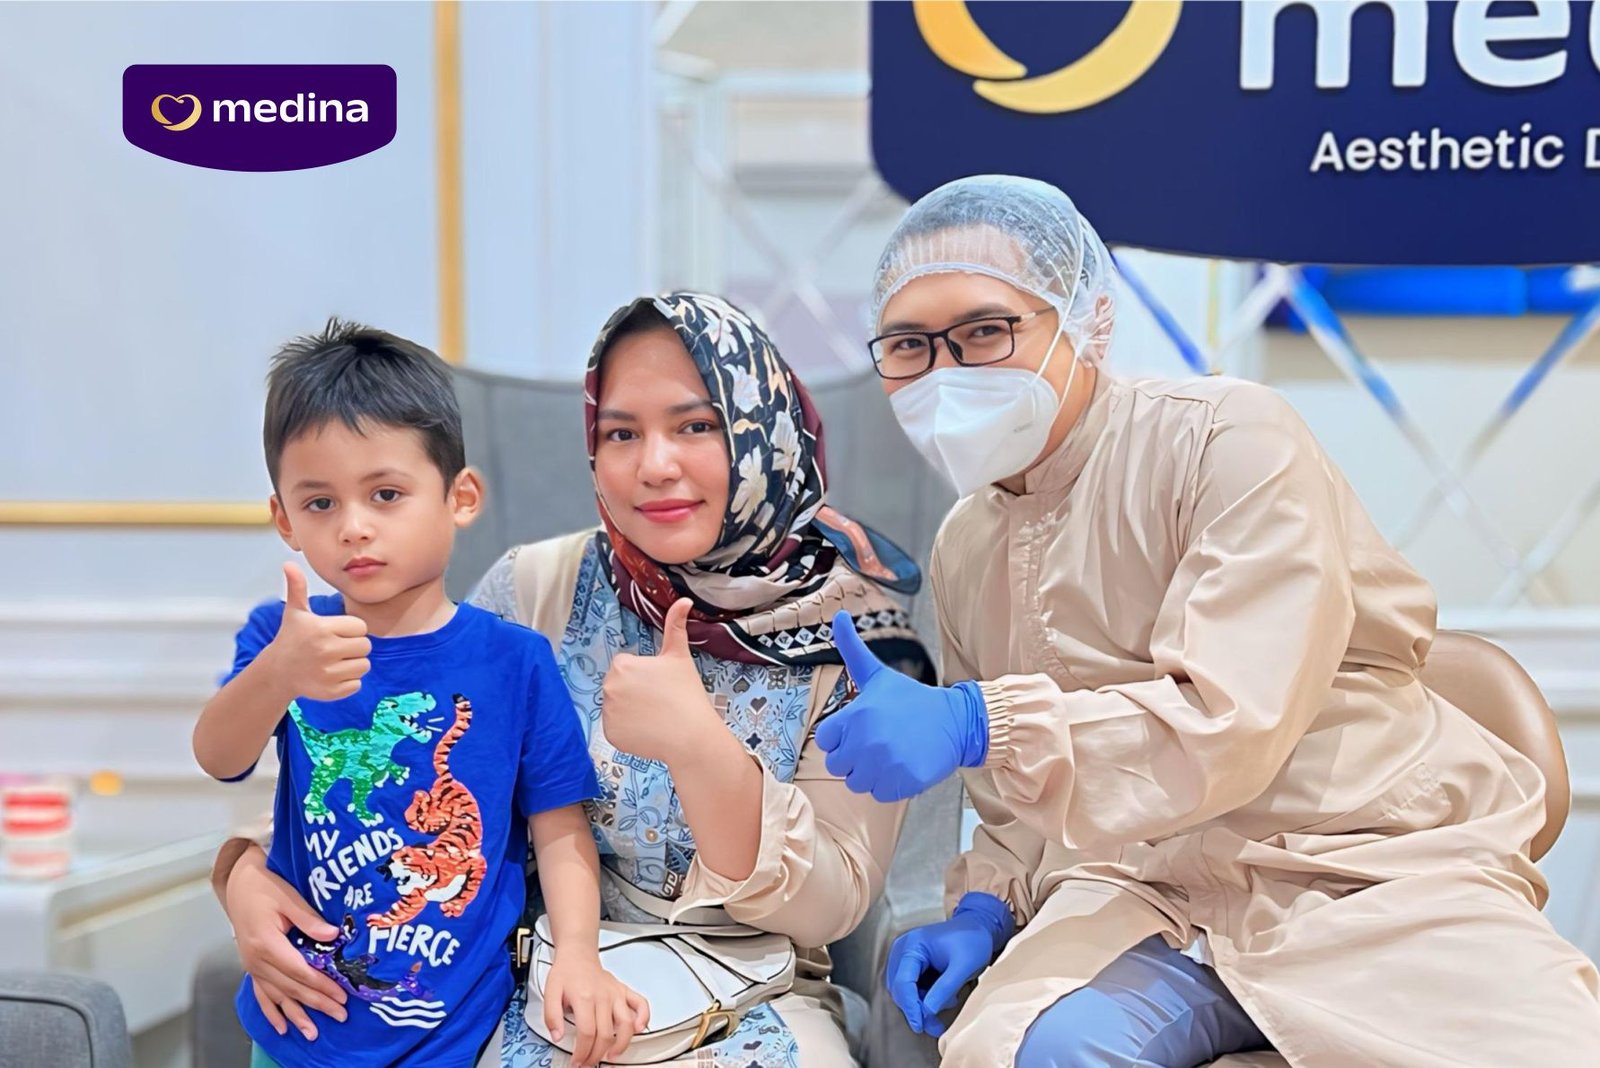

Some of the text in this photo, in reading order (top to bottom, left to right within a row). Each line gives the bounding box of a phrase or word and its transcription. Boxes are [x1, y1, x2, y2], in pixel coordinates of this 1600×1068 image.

[1240, 0, 1600, 89] me
[1310, 122, 1565, 172] Aesthetic
[305, 829, 340, 860] MY
[344, 883, 374, 911] ARE
[368, 924, 460, 967] FIERCE
